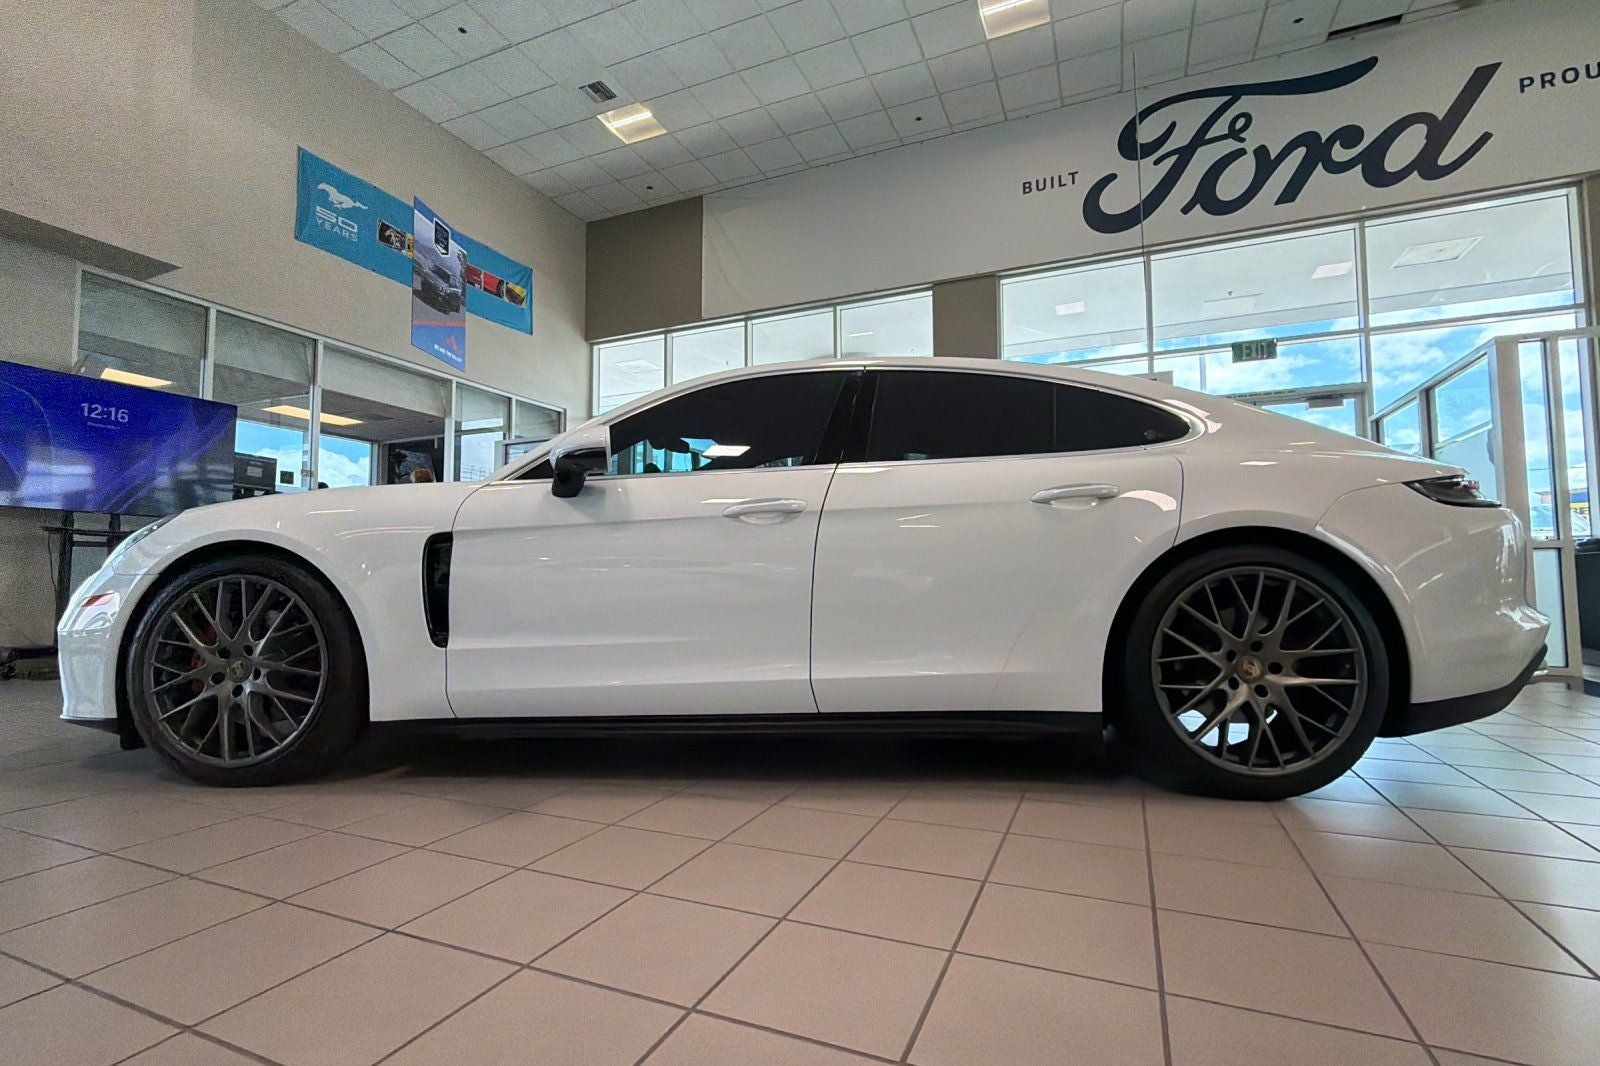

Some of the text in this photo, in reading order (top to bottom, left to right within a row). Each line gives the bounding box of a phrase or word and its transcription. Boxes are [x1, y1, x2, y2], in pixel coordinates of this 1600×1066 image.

[1022, 171, 1079, 195] BUILT
[1083, 55, 1502, 234] Ford
[316, 205, 358, 233] 50
[316, 216, 358, 242] YEARS
[1242, 341, 1268, 361] EXIT
[81, 403, 129, 423] 12:16
